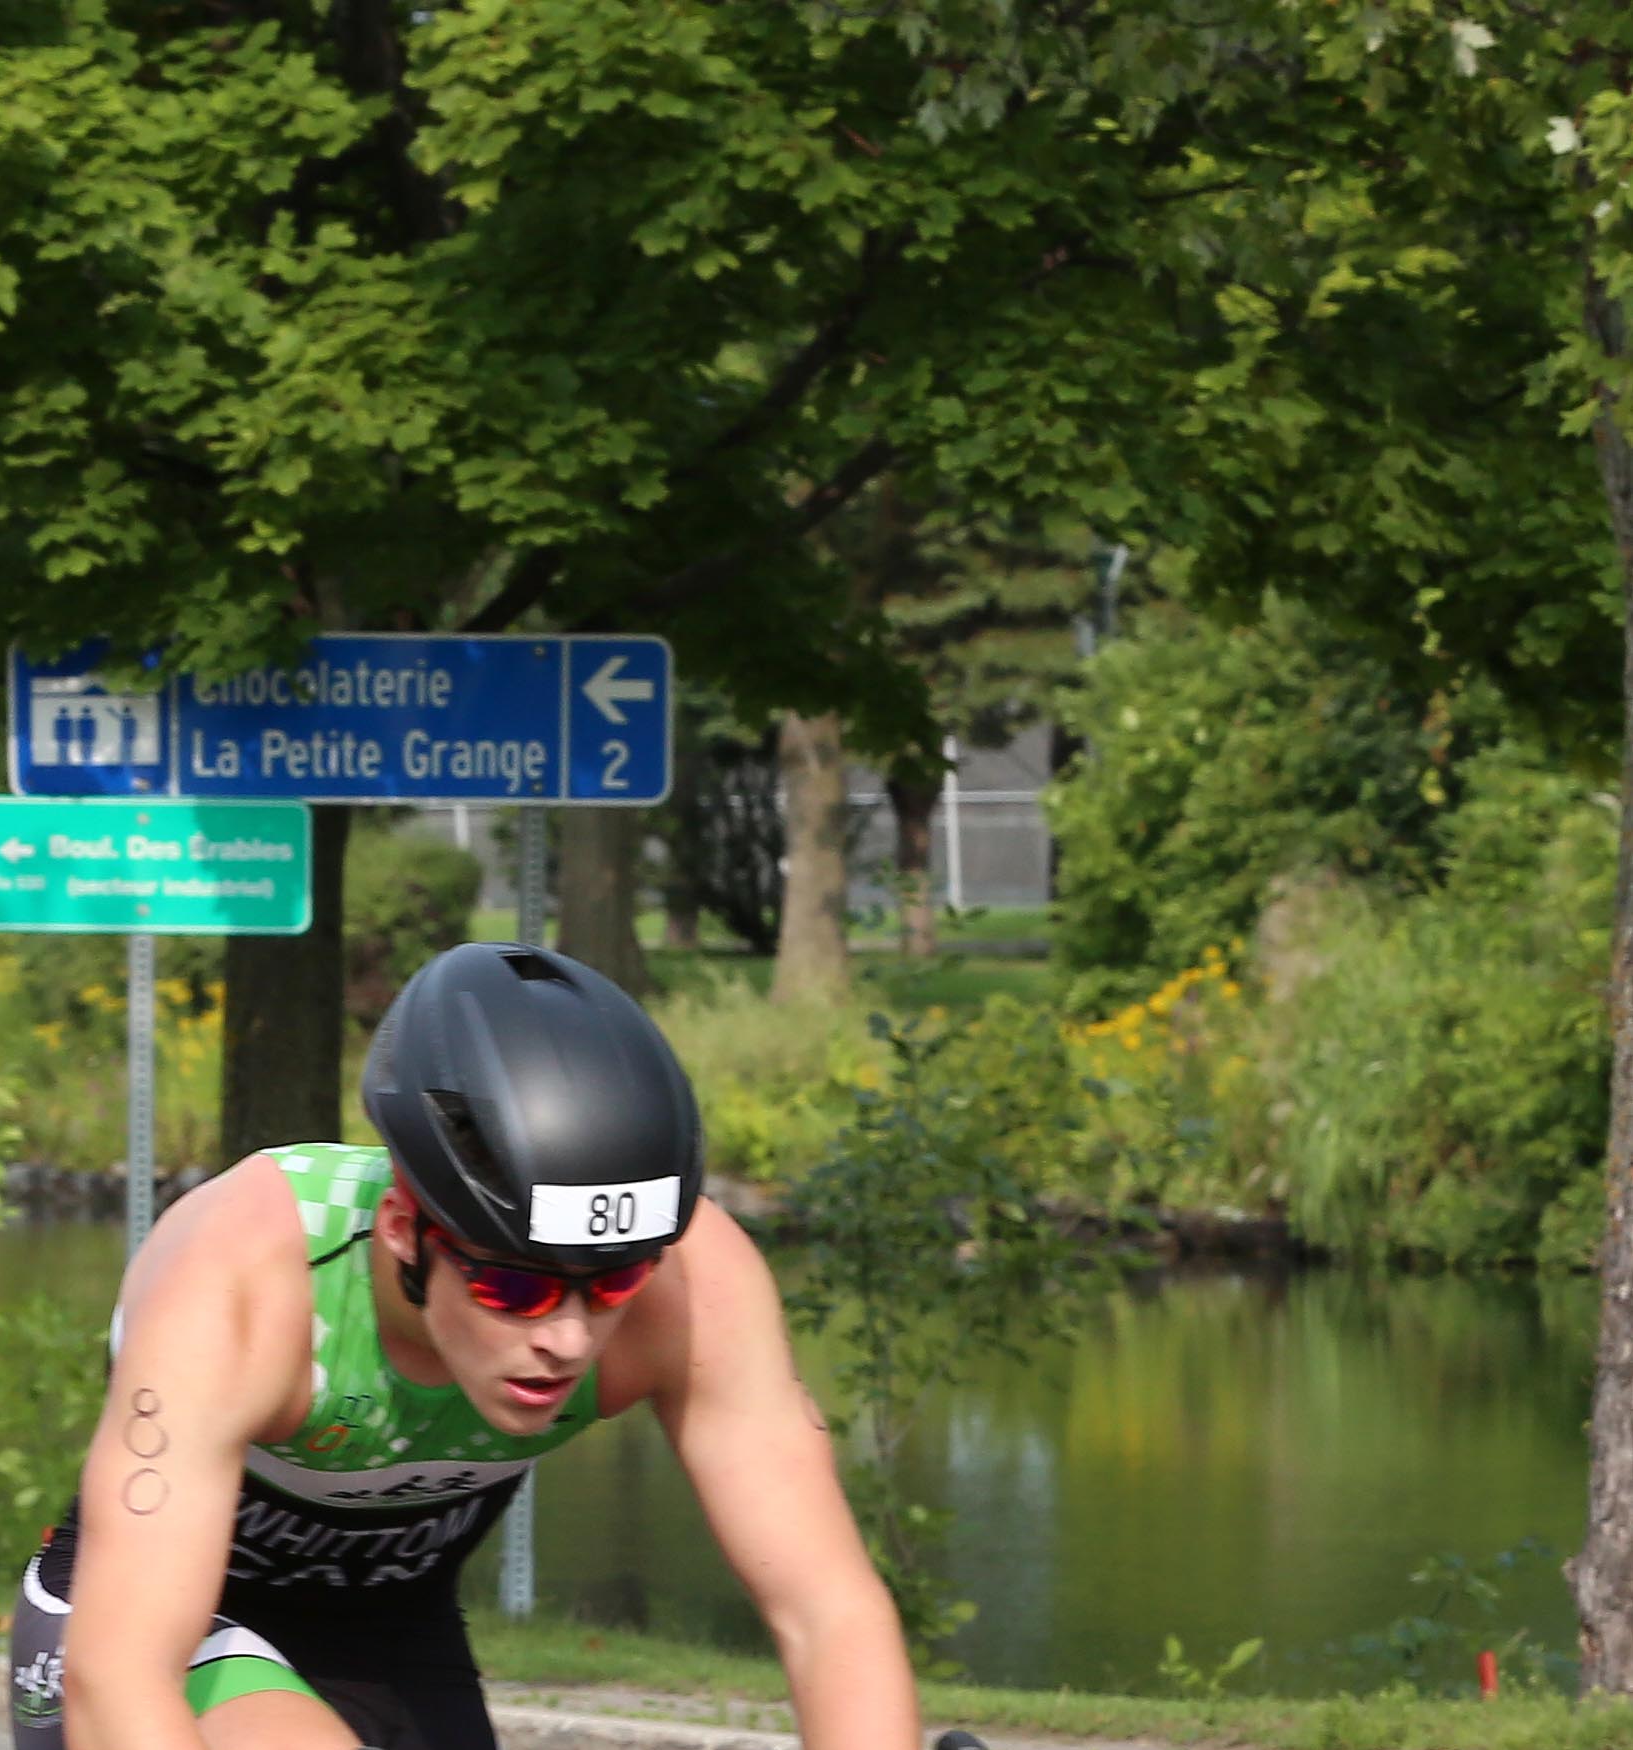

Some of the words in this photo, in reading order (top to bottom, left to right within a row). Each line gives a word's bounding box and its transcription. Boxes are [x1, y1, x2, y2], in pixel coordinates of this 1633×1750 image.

[191, 730, 241, 778] La
[260, 728, 382, 779] Petite
[403, 729, 546, 791] Grange
[601, 739, 629, 789] 2
[588, 1190, 636, 1236] 80
